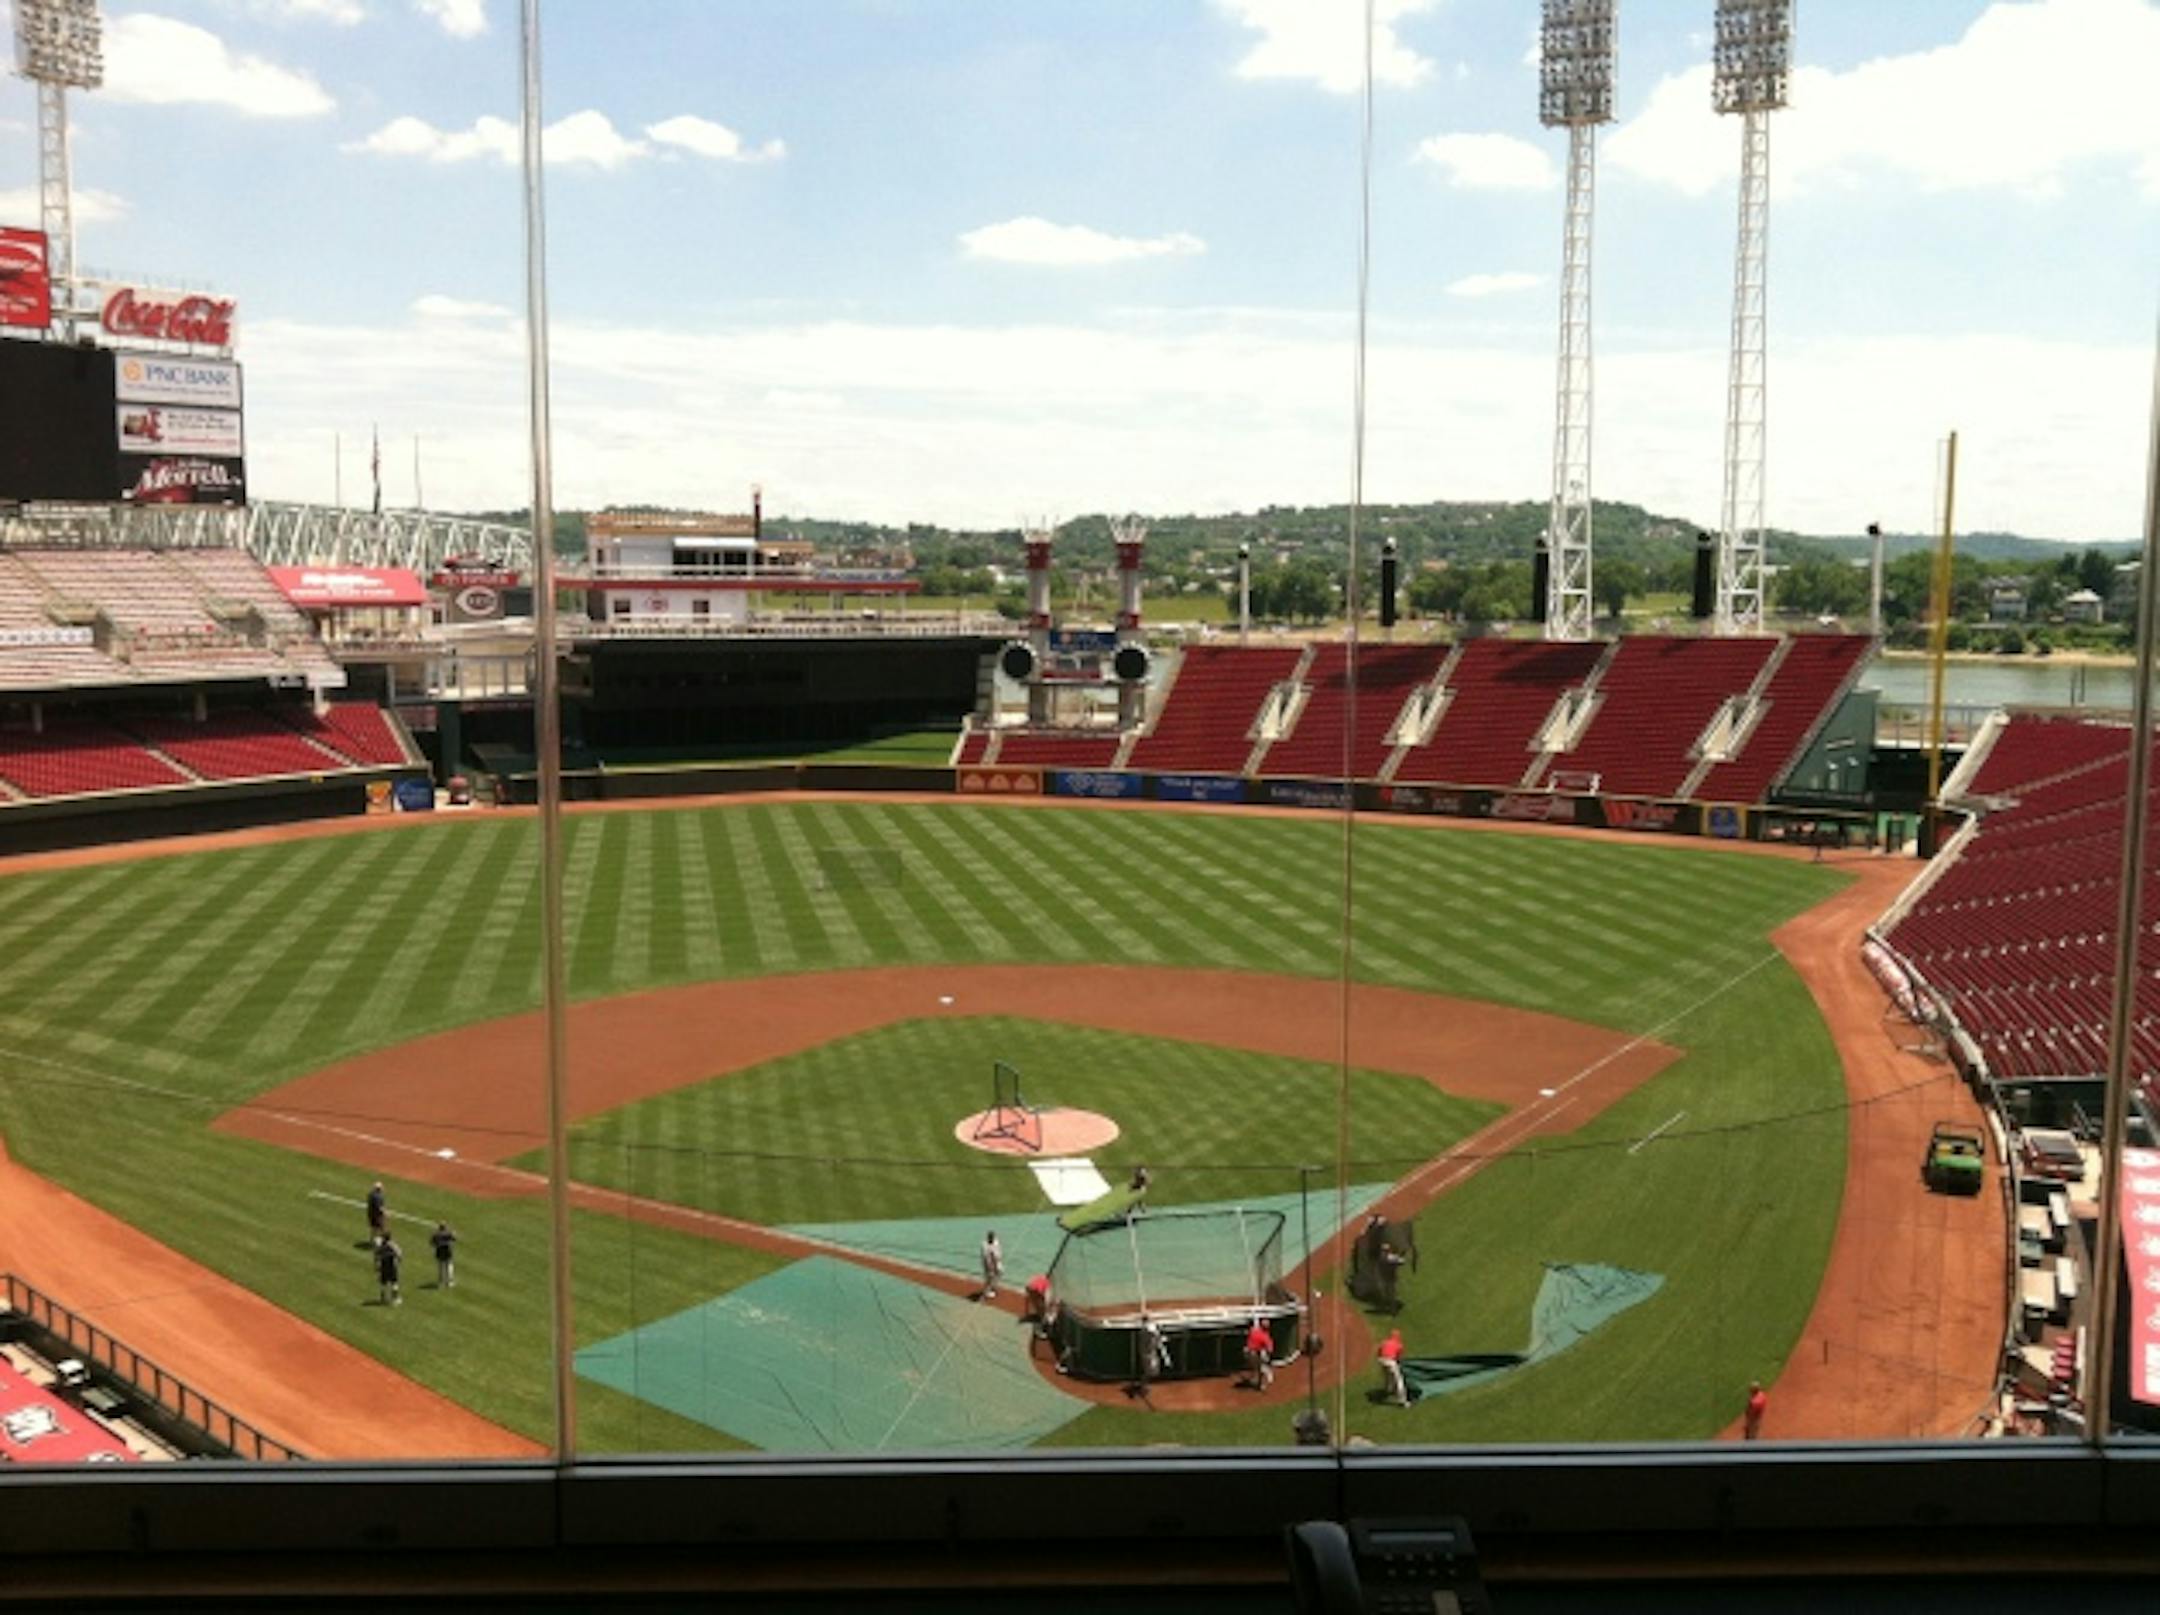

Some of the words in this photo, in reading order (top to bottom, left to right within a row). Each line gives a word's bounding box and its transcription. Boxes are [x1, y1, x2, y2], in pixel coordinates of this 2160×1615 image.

[102, 287, 236, 345] Coca-Cola
[145, 364, 182, 384] PNC
[185, 366, 231, 386] BANK
